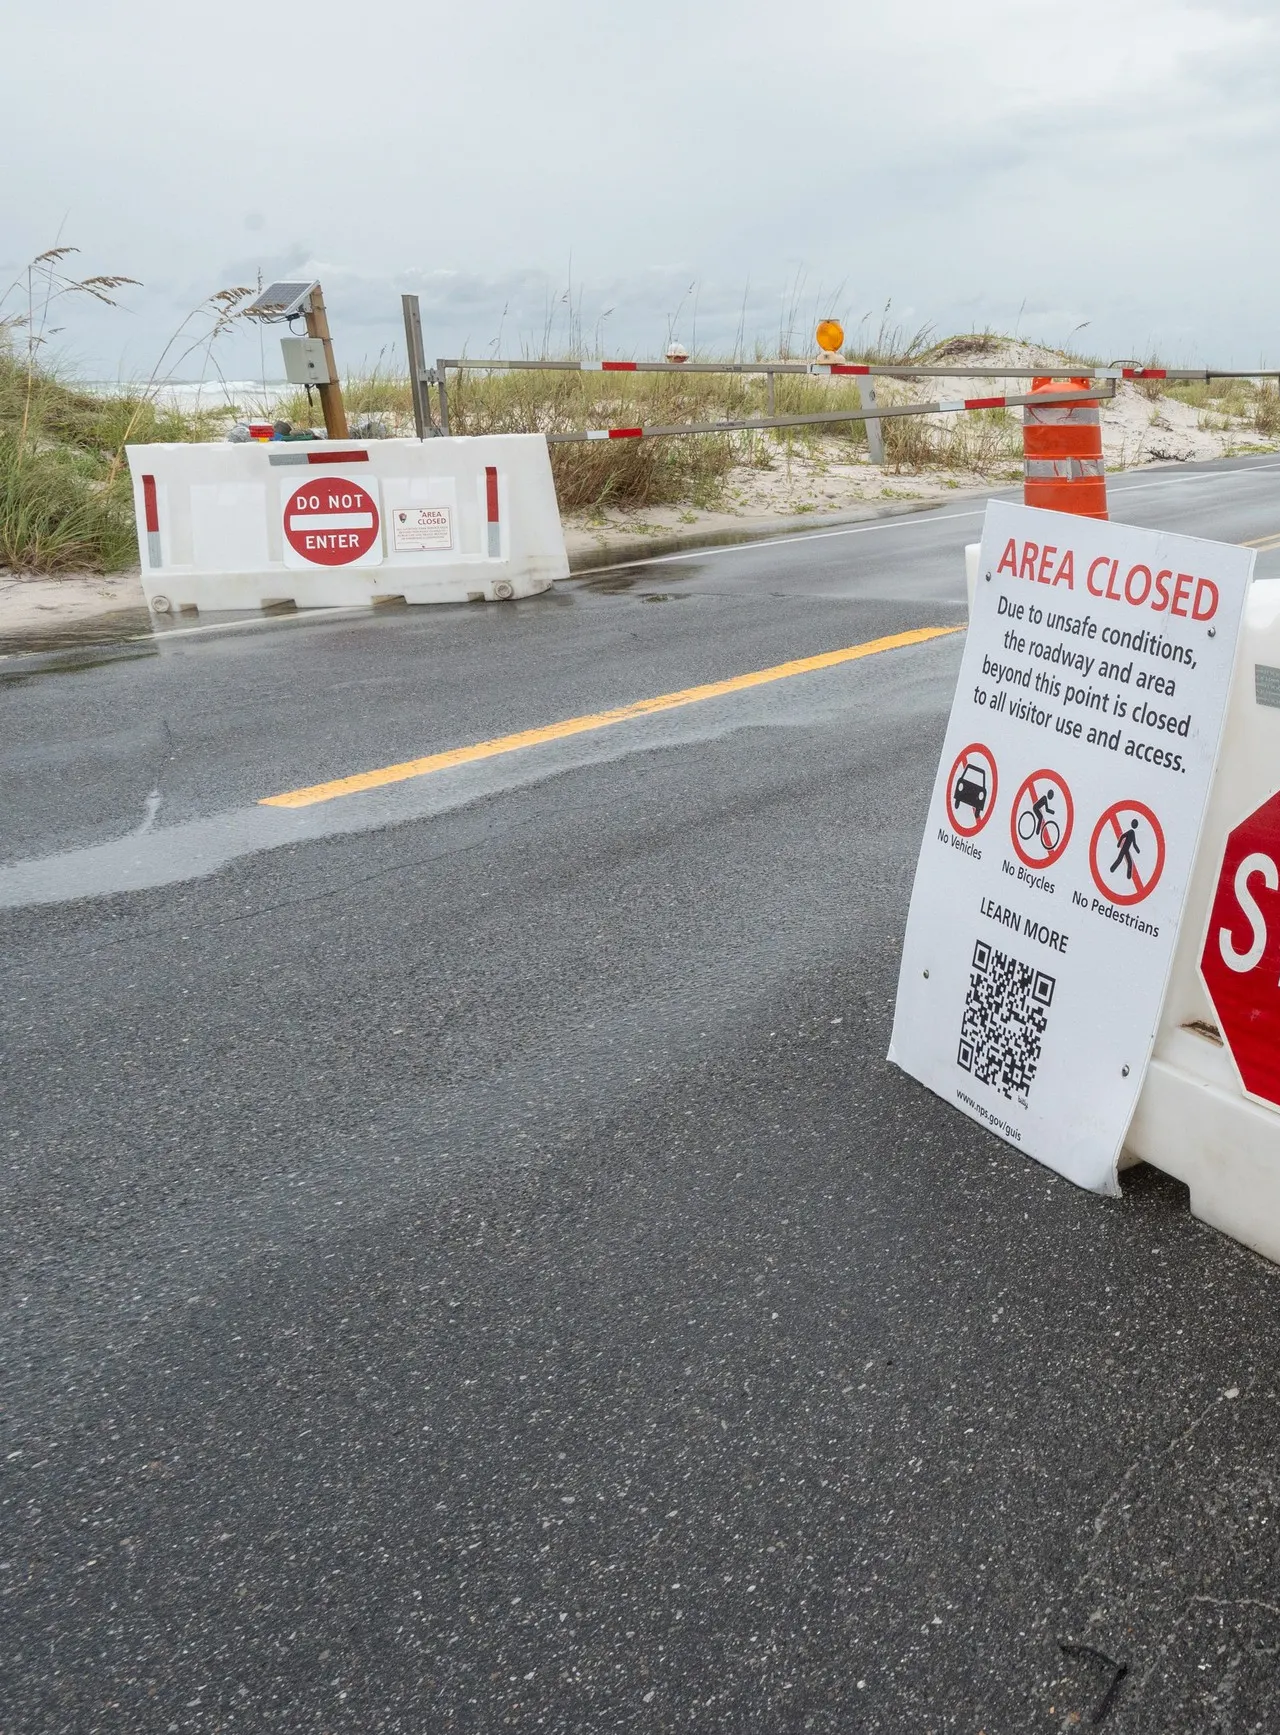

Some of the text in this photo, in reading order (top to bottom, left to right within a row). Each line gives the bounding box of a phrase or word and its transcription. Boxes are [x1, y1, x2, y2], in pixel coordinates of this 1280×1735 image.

[297, 494, 363, 510] DO NOT
[417, 517, 447, 525] CLOSED
[305, 534, 360, 550] ENTER
[997, 538, 1219, 622] AREA CLOSED
[997, 595, 1198, 670] Due to unsafe conditions,
[1004, 630, 1176, 697] the roadway and area
[982, 654, 1191, 739] beyond this point is closed
[974, 686, 1186, 773] to all visitor use and access.
[937, 828, 982, 861] No Vehicles
[1002, 860, 1056, 895] No Bicycles
[980, 897, 1069, 954] LEARN MORE
[1072, 890, 1160, 938] No Pedestrians
[956, 1089, 1022, 1141] www.nps.gov/guis
